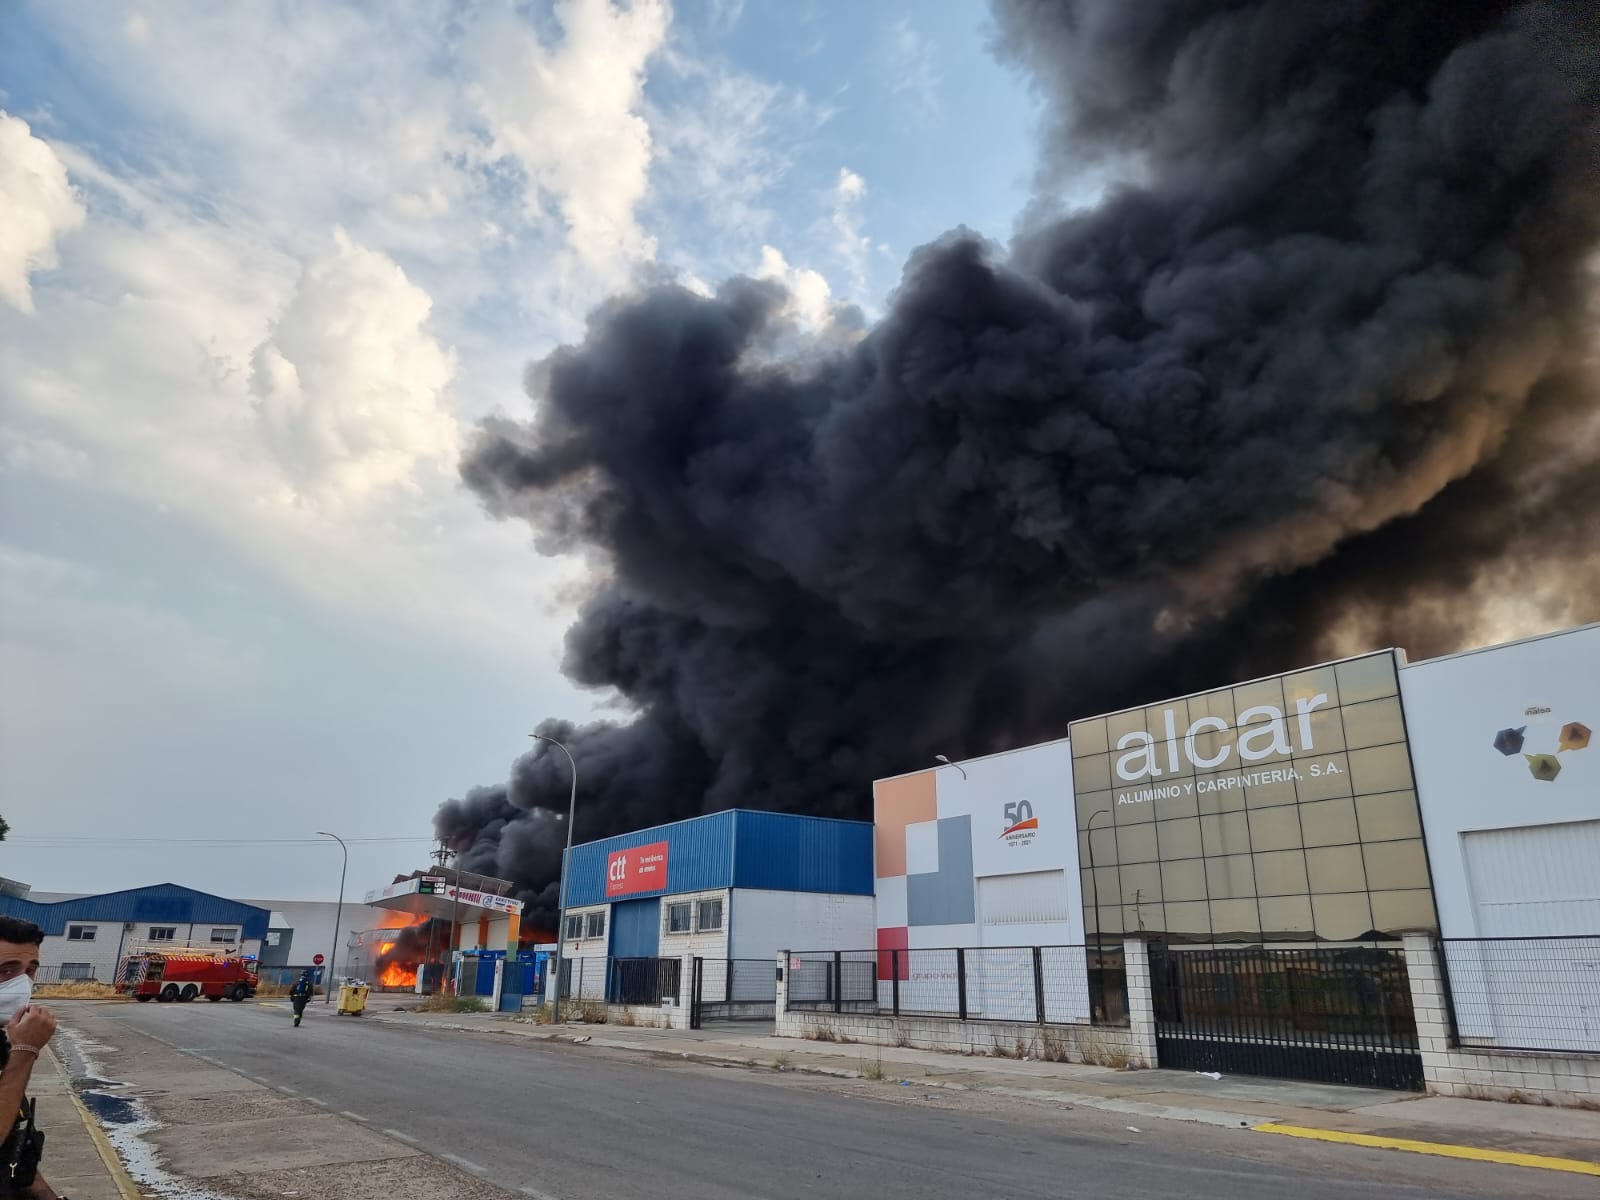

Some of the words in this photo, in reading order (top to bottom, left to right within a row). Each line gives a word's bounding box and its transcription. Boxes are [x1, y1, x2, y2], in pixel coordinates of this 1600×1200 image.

[1116, 693, 1328, 781] alcar
[1118, 786, 1181, 805] ALUMINIO
[1183, 783, 1196, 795] Y
[1197, 767, 1304, 794] CARPINTERIA,
[1310, 760, 1344, 778] S.A.
[1004, 800, 1033, 832] 50
[610, 855, 627, 881] ctt
